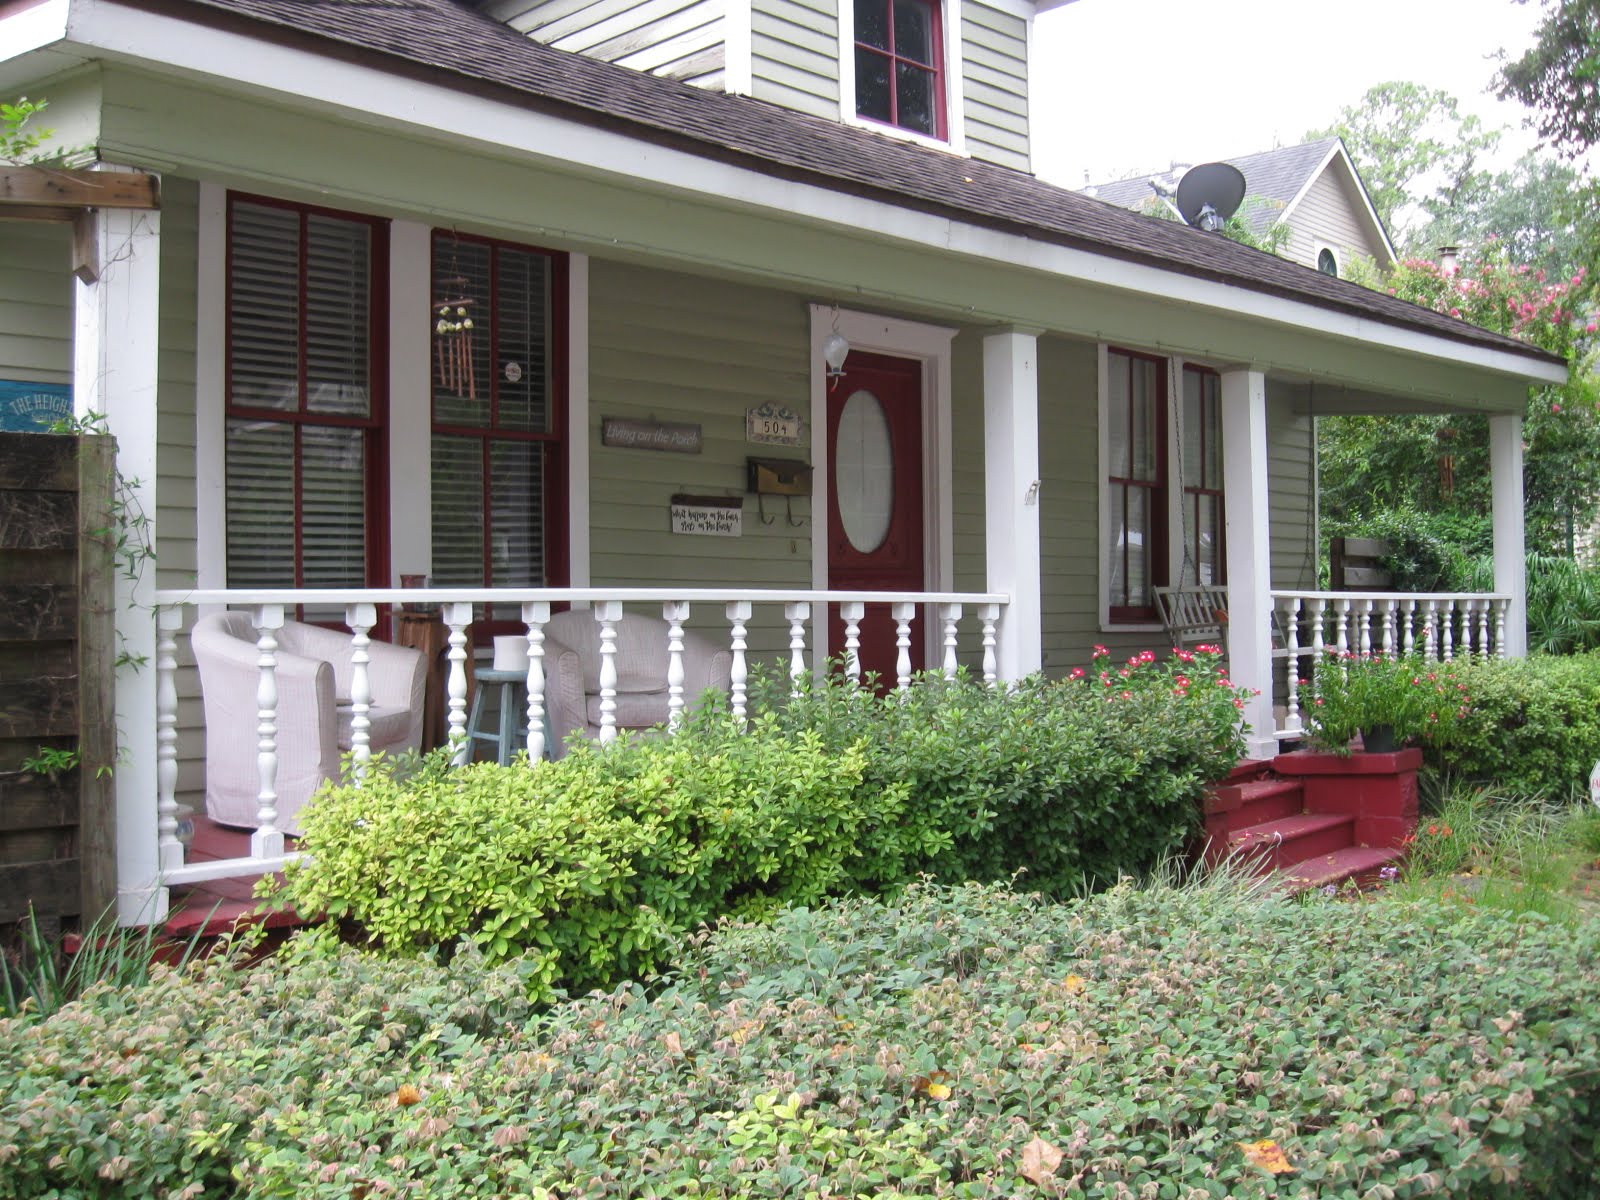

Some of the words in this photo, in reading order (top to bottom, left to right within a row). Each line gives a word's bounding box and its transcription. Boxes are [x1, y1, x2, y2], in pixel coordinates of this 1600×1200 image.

[9, 395, 33, 416] THE
[606, 424, 635, 442] Living
[637, 432, 651, 442] on
[654, 427, 670, 443] the
[671, 431, 698, 446] Porch
[764, 421, 787, 435] 504
